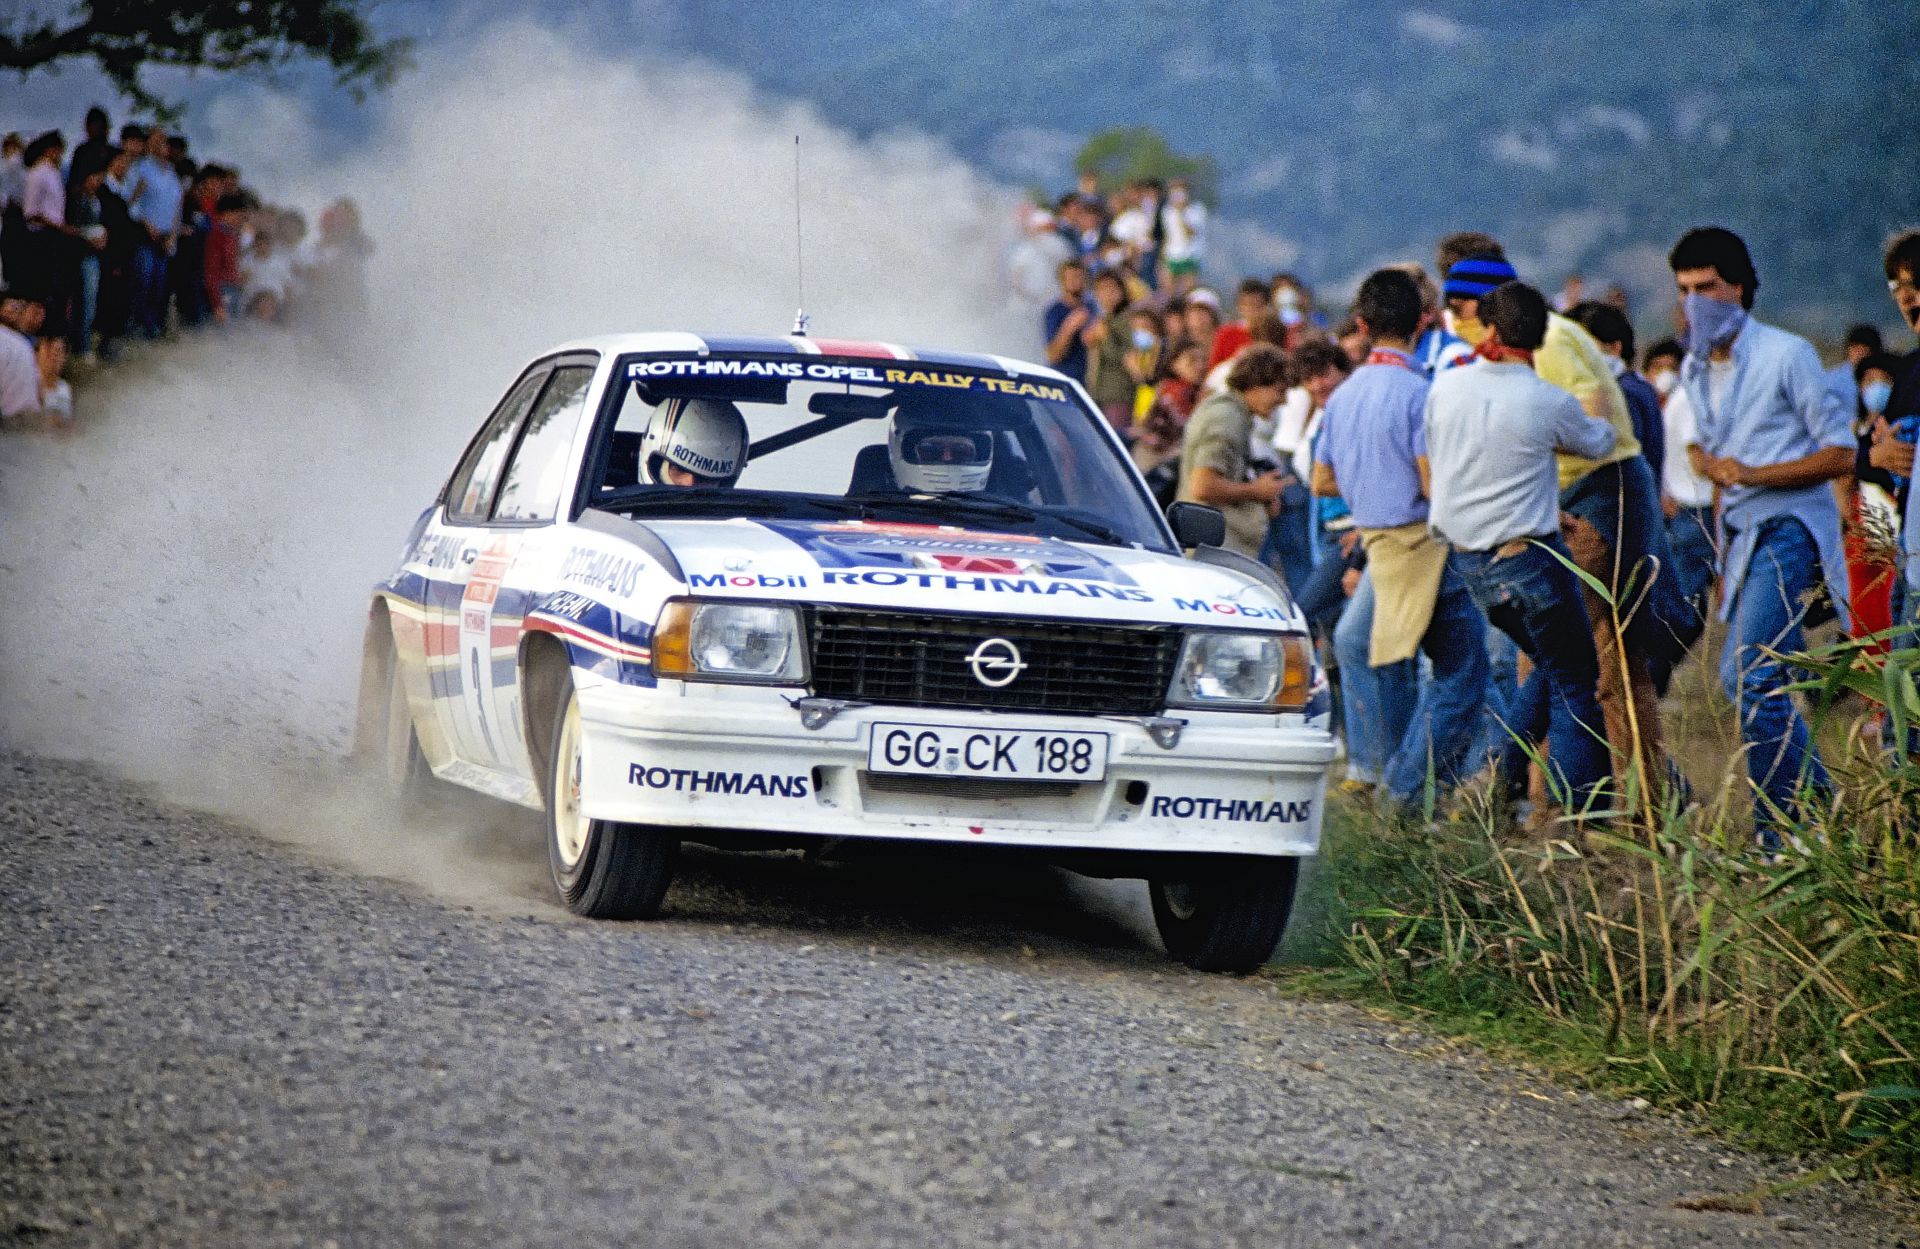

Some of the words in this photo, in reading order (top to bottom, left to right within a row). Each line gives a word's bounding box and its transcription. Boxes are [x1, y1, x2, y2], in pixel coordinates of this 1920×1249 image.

[628, 360, 803, 377] ROTHMANS
[807, 364, 884, 382] OPEL
[886, 370, 975, 388] RALLY
[979, 377, 1066, 402] TEAM
[672, 444, 734, 474] ROTHMANS
[689, 573, 808, 588] Mobil
[822, 571, 1154, 602] ROTHMANS
[1172, 597, 1288, 621] Mobil
[885, 729, 1021, 773] GG-CK
[1034, 736, 1093, 774] 188
[628, 762, 809, 798] ROTHMANS
[1150, 796, 1311, 823] ROTHMANS
